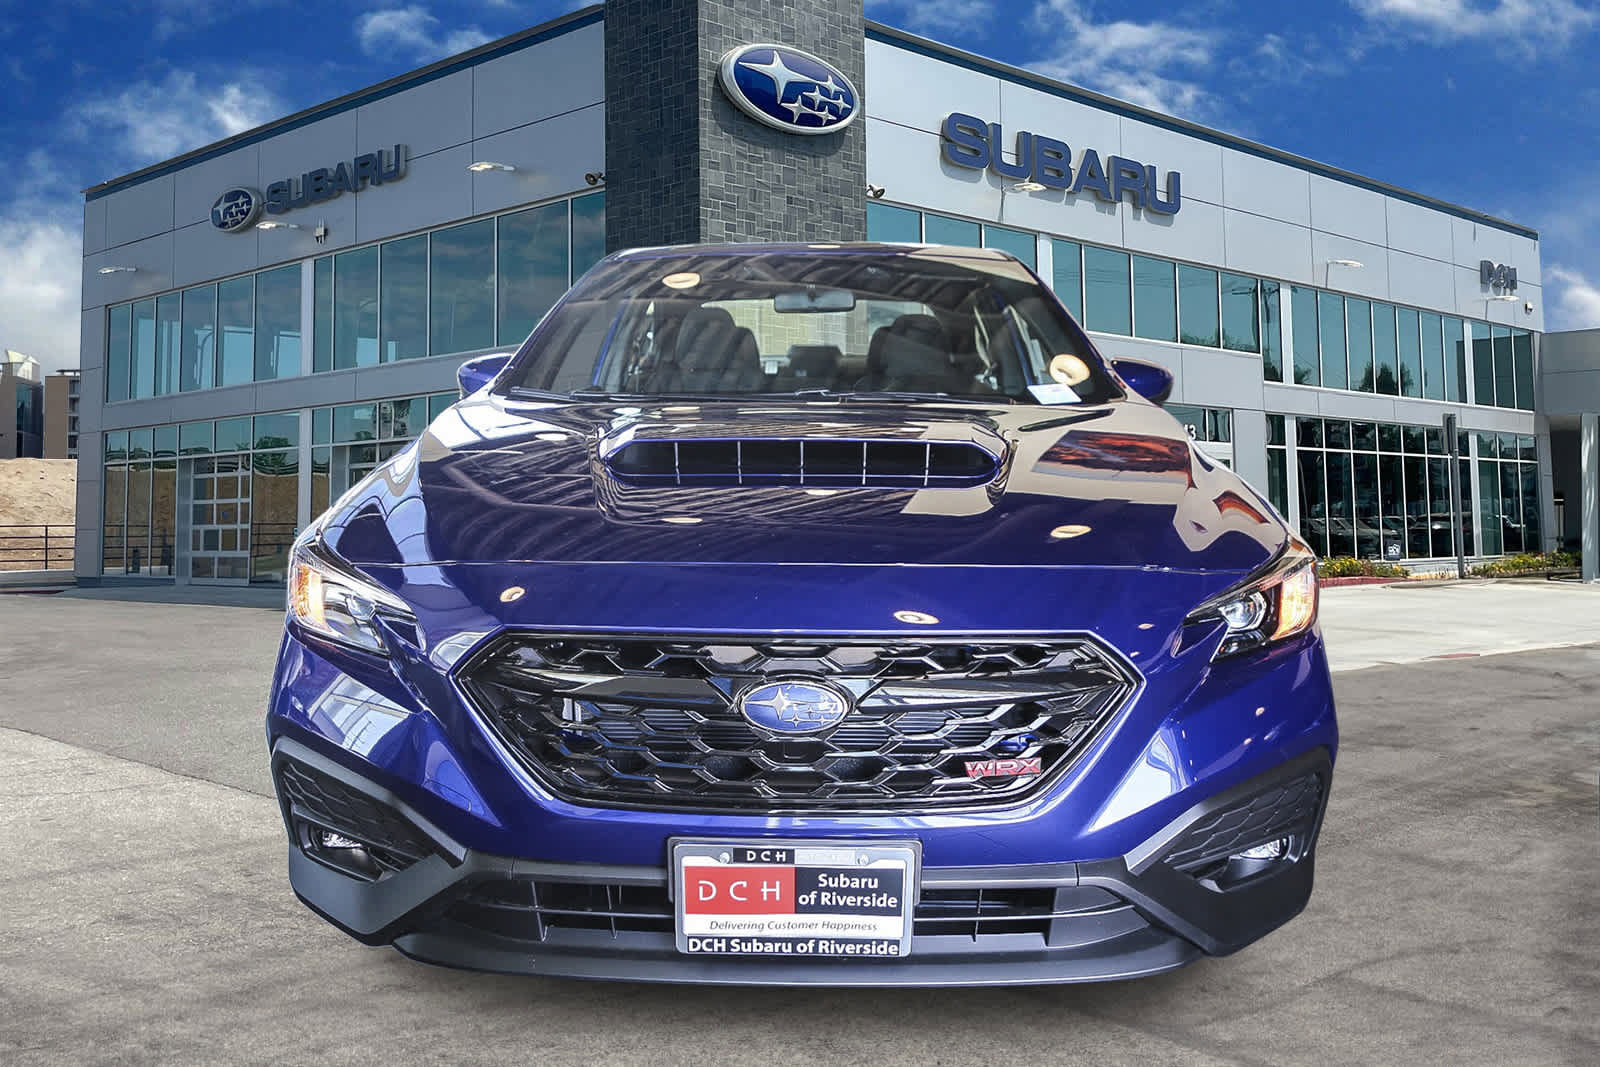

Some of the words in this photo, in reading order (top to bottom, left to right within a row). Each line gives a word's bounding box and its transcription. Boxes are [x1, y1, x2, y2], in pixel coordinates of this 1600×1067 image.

[939, 112, 1181, 215] SUBARU
[265, 143, 408, 214] SUBARU
[964, 757, 1041, 777] WRX
[746, 850, 787, 862] DCH
[818, 873, 878, 889] Subaru
[698, 880, 782, 901] DCH
[798, 892, 815, 906] of
[820, 892, 898, 908] Riverside
[709, 920, 765, 932] Delivering
[767, 920, 819, 930] Customer
[821, 920, 878, 931] Happiness
[689, 939, 726, 952] DCH
[730, 938, 792, 953] Subaru
[796, 939, 813, 954] of
[818, 939, 899, 955] Riverside
